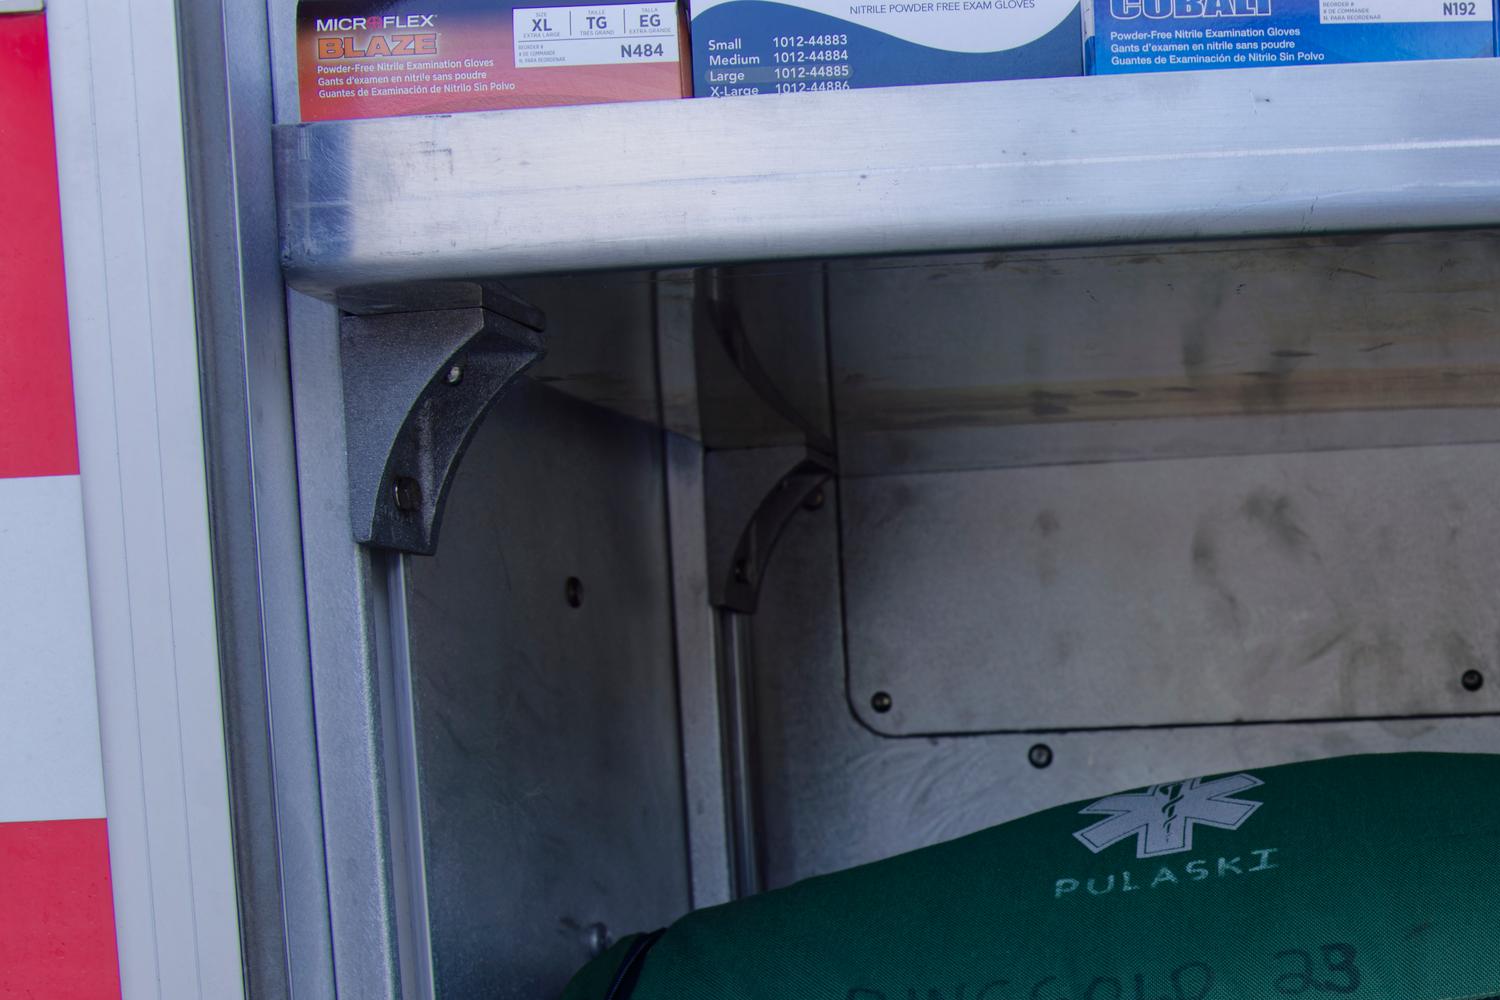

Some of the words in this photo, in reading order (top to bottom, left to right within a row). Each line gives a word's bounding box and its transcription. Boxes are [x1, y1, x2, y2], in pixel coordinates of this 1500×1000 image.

[850, 5, 887, 15] NITRILE
[889, 2, 934, 13] POWDER
[936, 1, 960, 11] FREE
[963, 0, 992, 10] EXAM
[994, 0, 1035, 9] GLOVES
[1443, 2, 1476, 16] N192
[532, 18, 552, 32] XL
[586, 16, 607, 30] TG
[639, 14, 661, 28] EG
[1110, 30, 1172, 40] Powder-Free
[1175, 29, 1202, 39] Nitrile
[1205, 28, 1265, 38] Examination
[1267, 27, 1301, 37] Gloves
[318, 33, 437, 59] BLAZE
[708, 38, 742, 51] Small
[772, 34, 847, 48] 1012-44883
[1110, 43, 1139, 53] Gants
[1142, 43, 1189, 52] d'examen
[1192, 43, 1204, 51] en
[1206, 41, 1233, 50] nitrile
[1236, 42, 1258, 50] sans
[1261, 39, 1295, 51] poudre
[620, 43, 664, 58] N484
[709, 54, 760, 66] Medium
[773, 50, 848, 63] 1012-44884
[317, 63, 374, 74] Powder-Free
[377, 62, 404, 71] Nitrile
[406, 59, 462, 70] Examination
[464, 58, 494, 68] Gloves
[1111, 56, 1152, 66] Guantes
[1154, 55, 1166, 64] de
[1169, 53, 1231, 63] Examinación
[1233, 53, 1246, 62] de
[1248, 52, 1277, 62] Nitrilo
[1279, 51, 1295, 61] Sin
[1297, 51, 1324, 61] Polvo
[318, 76, 344, 86] Gants
[346, 75, 388, 85] d'examen
[404, 73, 430, 82] nitrile
[432, 73, 452, 81] sans
[454, 71, 487, 82] poudre
[710, 71, 745, 84] Large
[774, 65, 849, 79] 1012-44885
[318, 88, 355, 98] Guantes
[358, 87, 368, 97] de
[371, 85, 427, 96] Examinación
[430, 85, 441, 93] de
[444, 82, 472, 92] Nitrilo
[474, 81, 488, 92] Sin
[490, 81, 516, 91] Polvo
[710, 86, 759, 97] X-Large
[775, 80, 850, 94] 1012-44886
[1053, 846, 1280, 900] PULASKI
